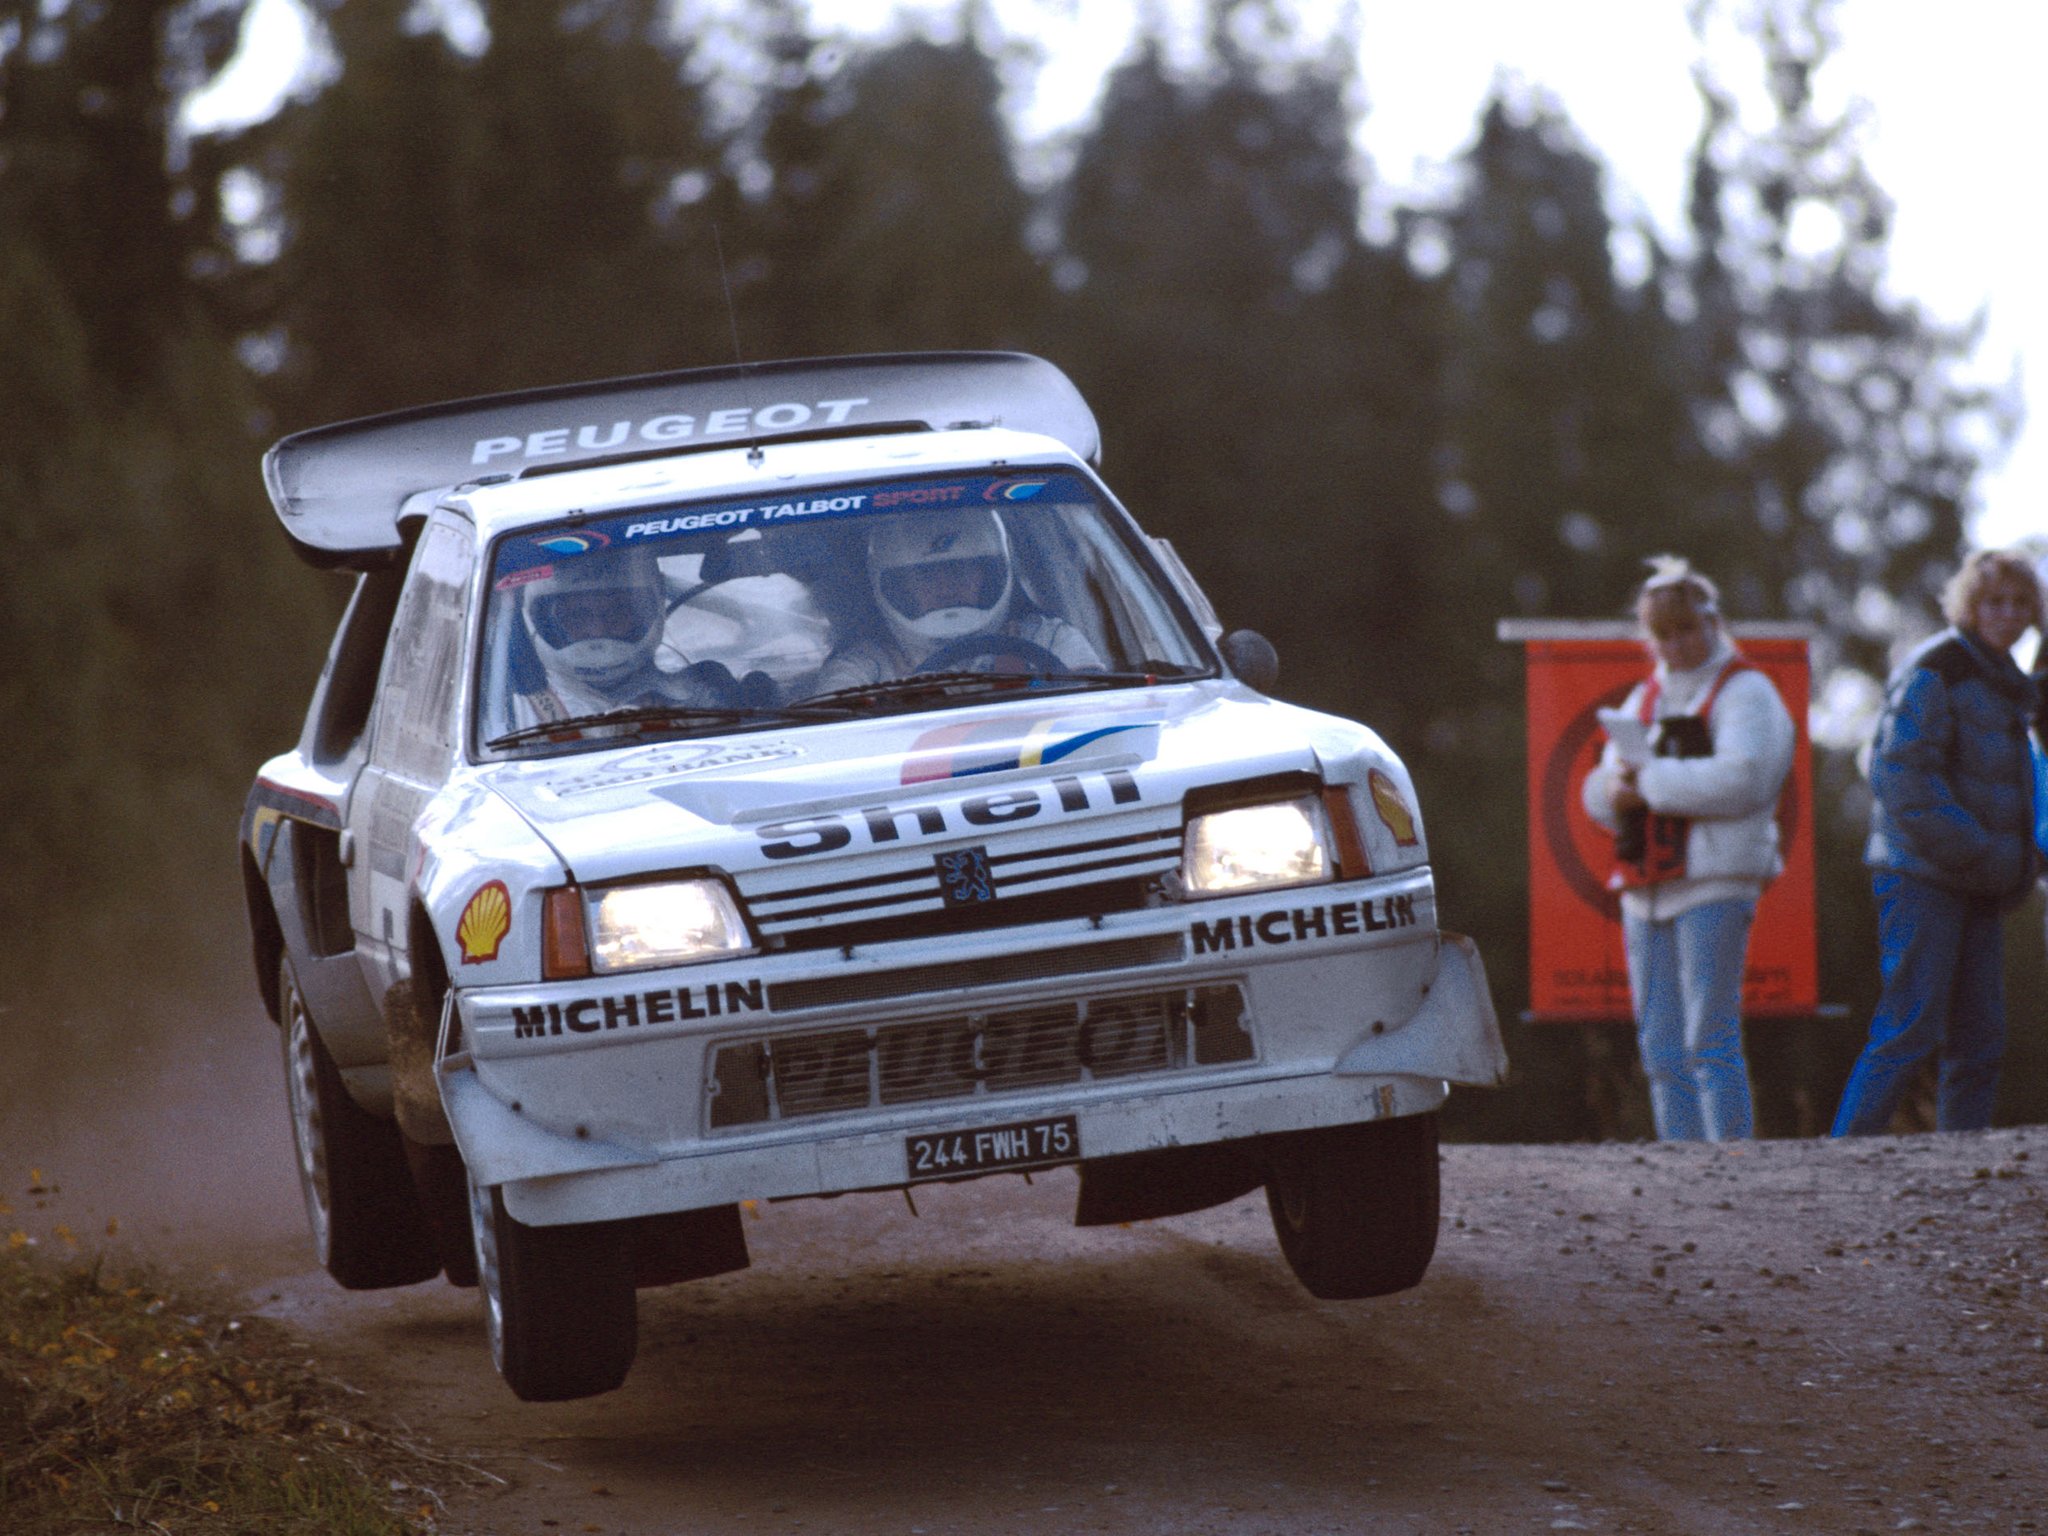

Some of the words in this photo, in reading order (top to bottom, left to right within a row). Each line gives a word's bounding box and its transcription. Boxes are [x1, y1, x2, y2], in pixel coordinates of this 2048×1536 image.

[471, 398, 870, 465] PEUGEOT
[625, 508, 754, 538] PEUGEOT
[762, 495, 867, 520] TALBOT
[872, 485, 966, 508] SPORT
[755, 769, 1142, 860] Shell
[1190, 893, 1417, 955] MICHELIN
[512, 979, 764, 1039] MICHELIN
[915, 1137, 968, 1170] 244
[975, 1128, 1030, 1164] FWH
[1034, 1123, 1071, 1155] 75
